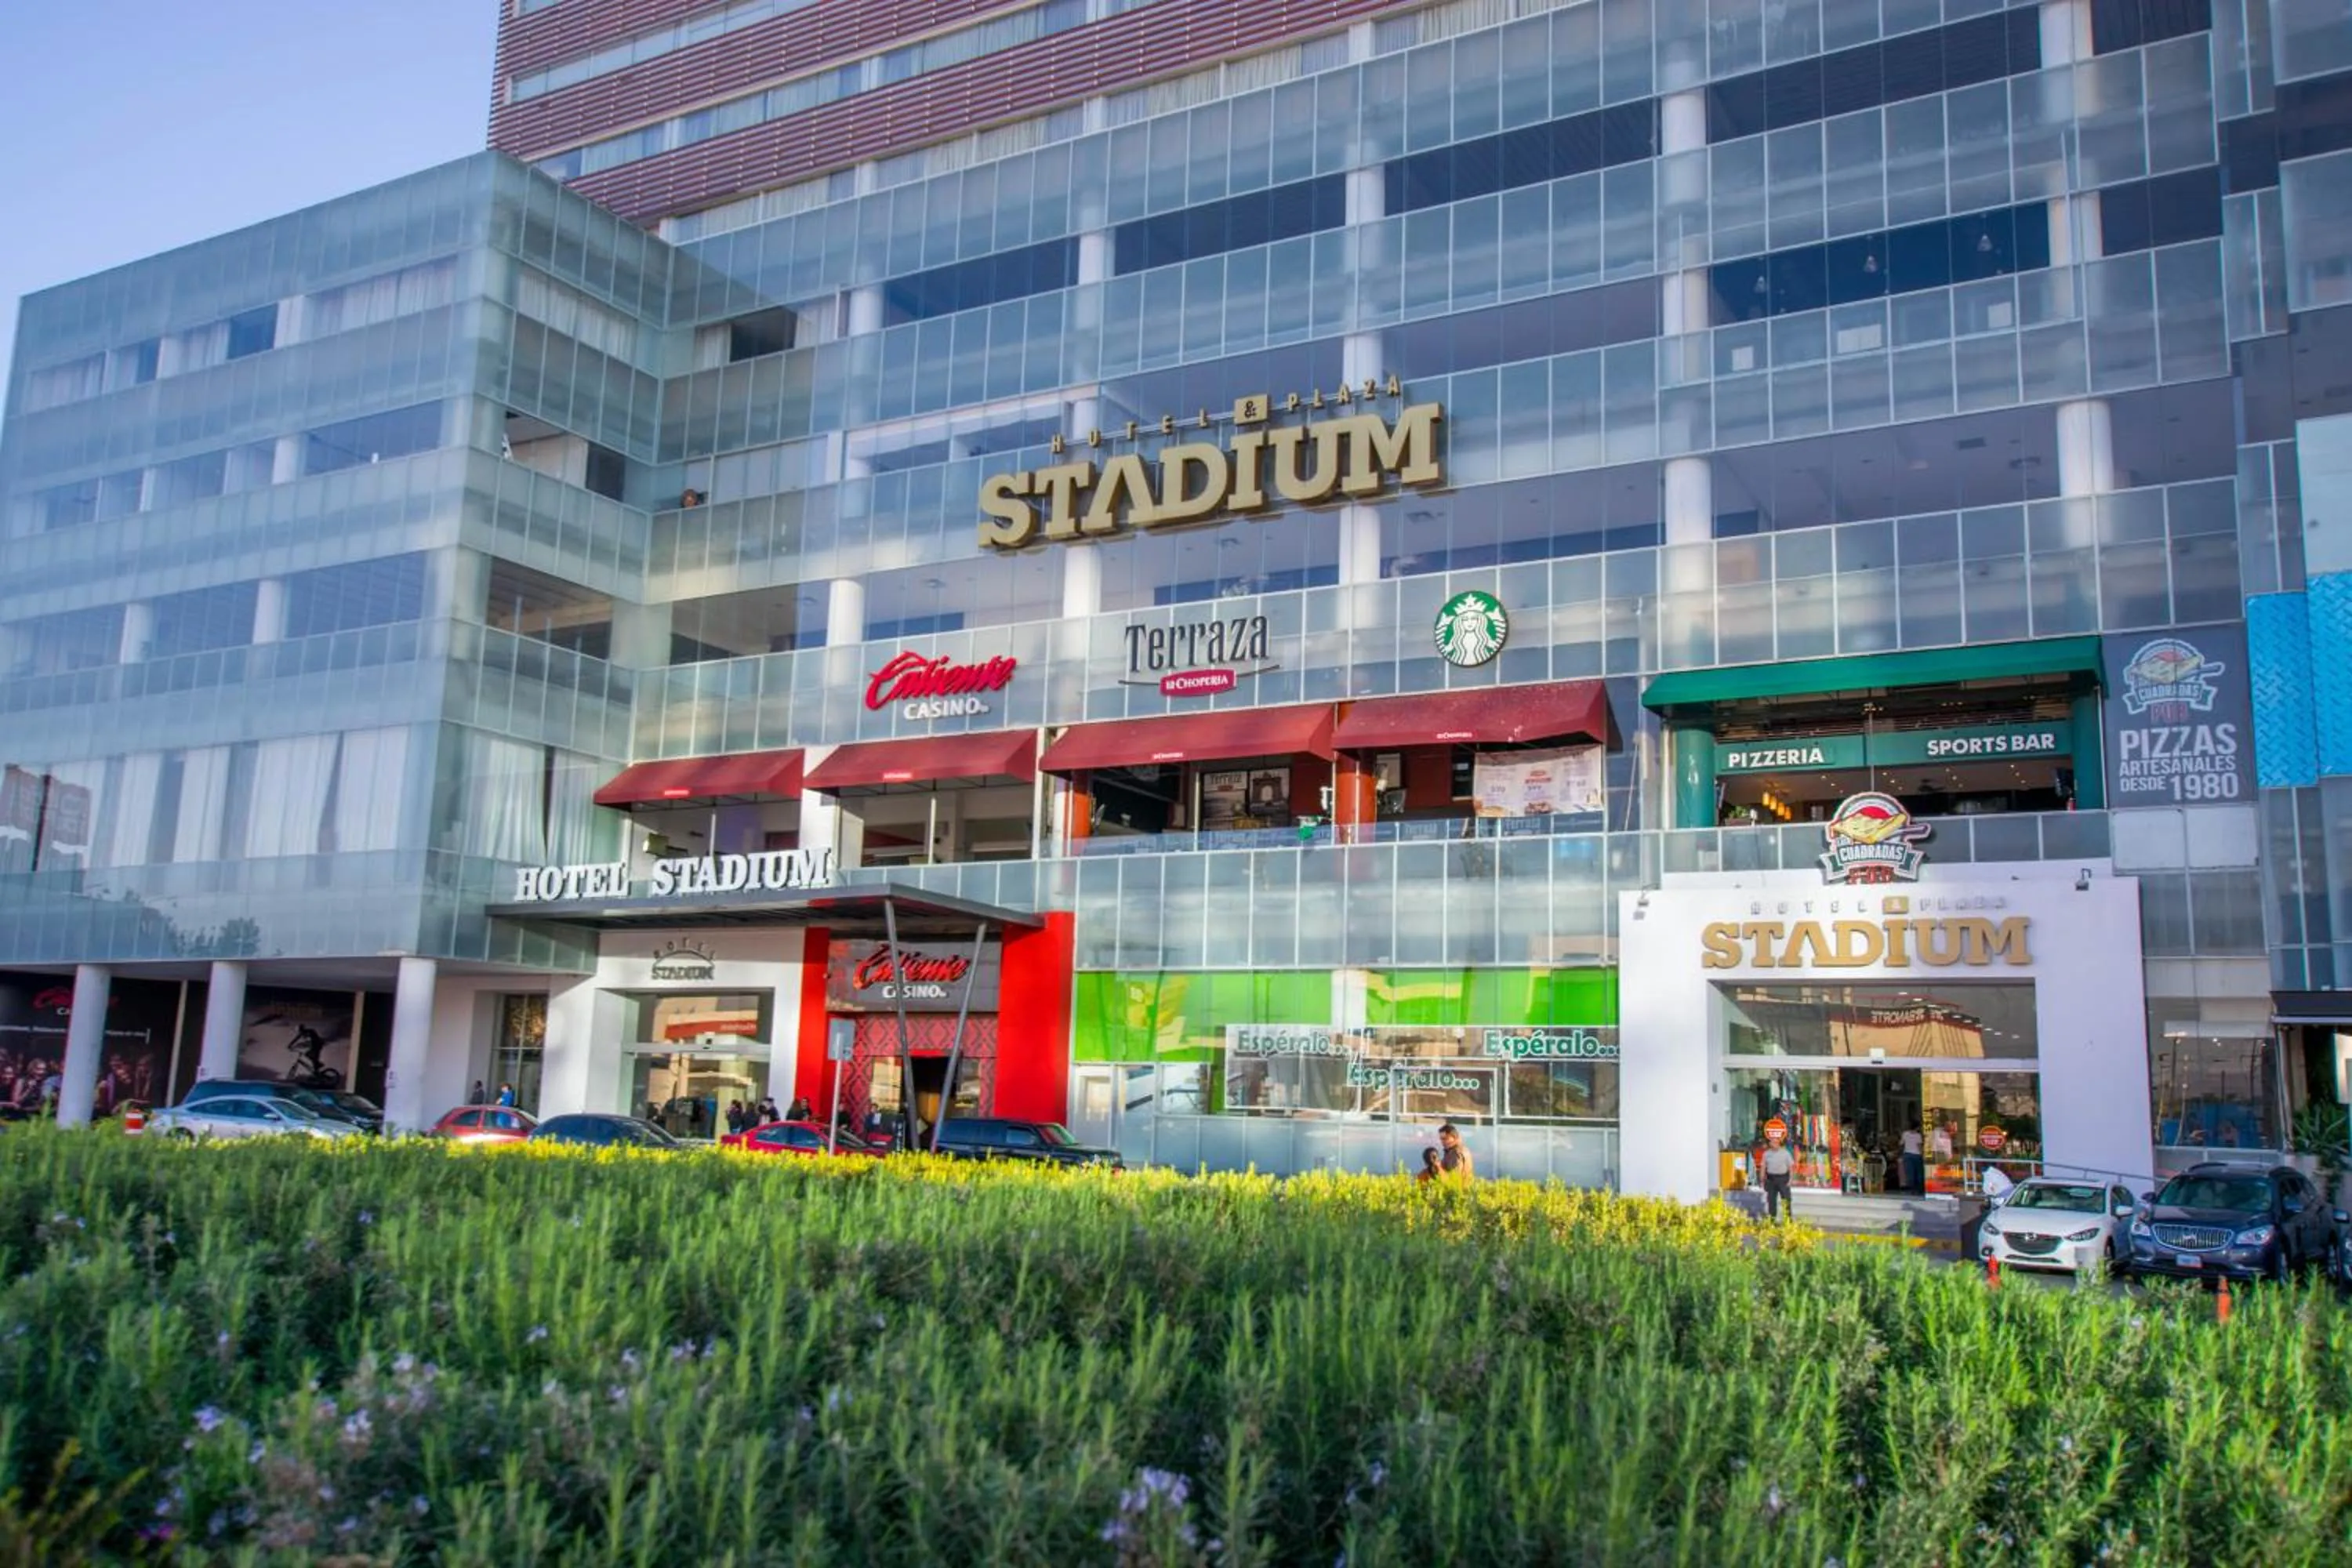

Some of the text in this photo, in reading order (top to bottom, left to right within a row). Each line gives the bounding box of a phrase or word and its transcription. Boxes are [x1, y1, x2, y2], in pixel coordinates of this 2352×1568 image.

[1051, 408, 1207, 453] HOTEL
[1287, 374, 1402, 412] PLAZA
[978, 403, 1444, 549] STADIUM
[1124, 615, 1270, 673] Terraza
[903, 697, 982, 720] CASINO
[1729, 747, 1824, 768] PIZZERIA
[1927, 733, 2055, 756] SPORTS BAR
[2119, 723, 2237, 760] PIZZAS
[2119, 755, 2237, 777] ARTESANALES
[2120, 772, 2239, 800] DESDE 1980
[1839, 844, 1904, 861] CUADRADAS
[514, 847, 832, 902] HOTEL STADIUM
[1701, 917, 2032, 969] STADIUM
